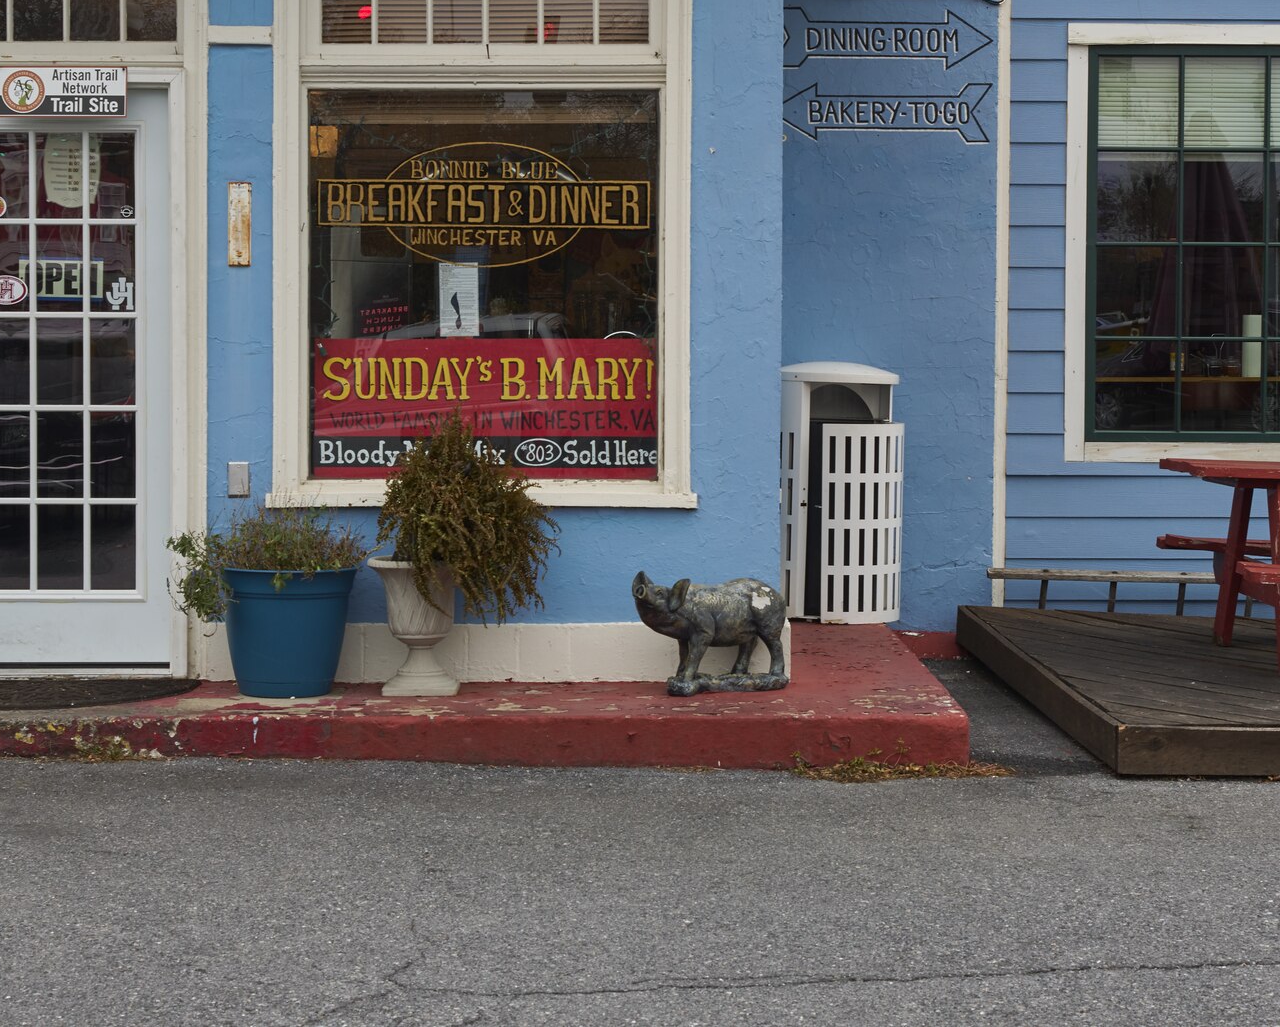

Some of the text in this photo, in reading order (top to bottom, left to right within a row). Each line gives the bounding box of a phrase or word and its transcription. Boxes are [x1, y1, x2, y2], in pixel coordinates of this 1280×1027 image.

[52, 69, 118, 81] Artisan Trail
[62, 82, 108, 94] Network
[51, 97, 119, 113] Trail Site
[410, 160, 559, 181] BONNIE BLUE
[327, 183, 640, 225] BREAKFAST & DINNER
[410, 229, 558, 247] WINCHESTER VA
[25, 262, 98, 296] OPEN
[323, 355, 493, 401] SUNDAY's
[536, 357, 655, 401] MARY!
[331, 412, 386, 430] WORLD
[393, 410, 455, 429] FAMO
[473, 412, 493, 429] IN
[631, 411, 656, 431] VA
[319, 439, 401, 468] Bloody
[563, 439, 657, 466] Sold Here
